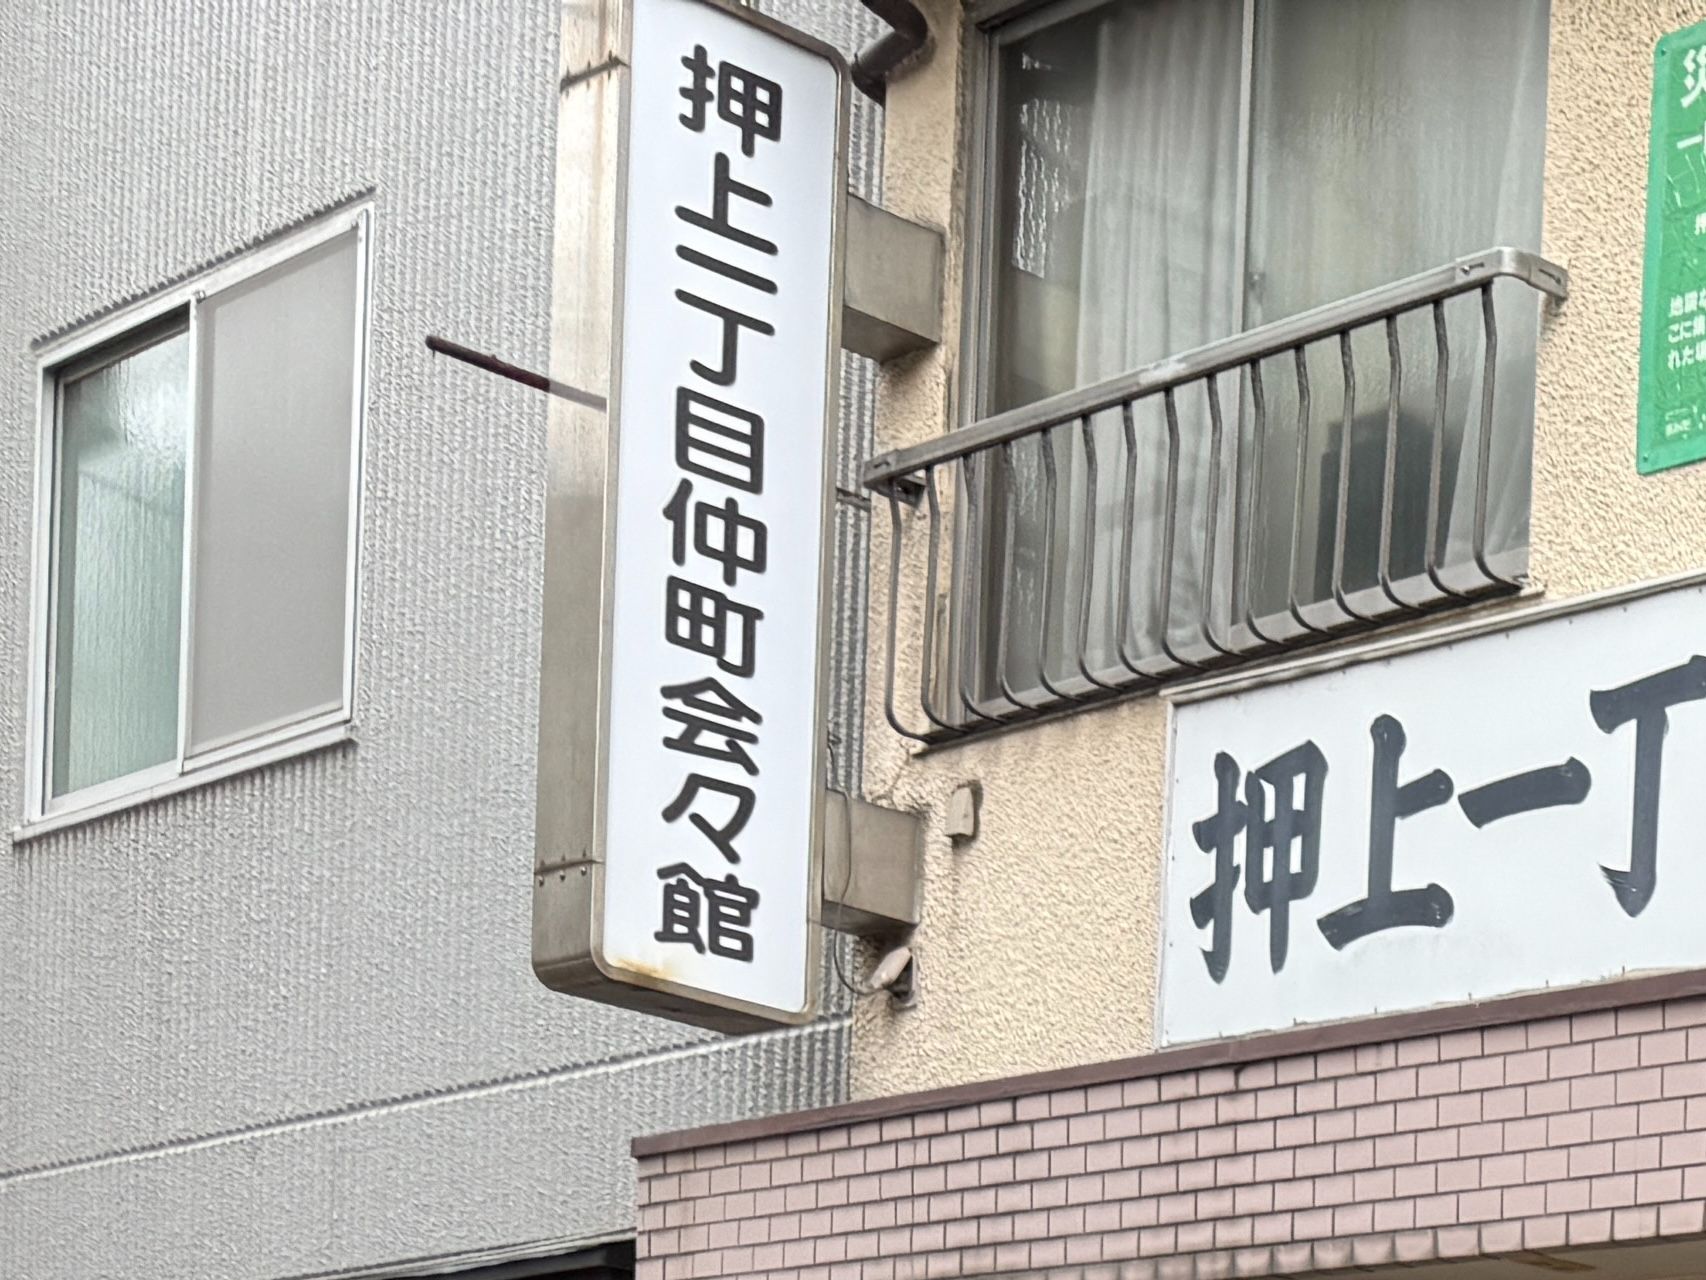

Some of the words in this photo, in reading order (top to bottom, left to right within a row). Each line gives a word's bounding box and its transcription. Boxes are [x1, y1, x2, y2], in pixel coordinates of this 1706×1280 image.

[655, 44, 782, 963] 押上一丁目仲町会々館
